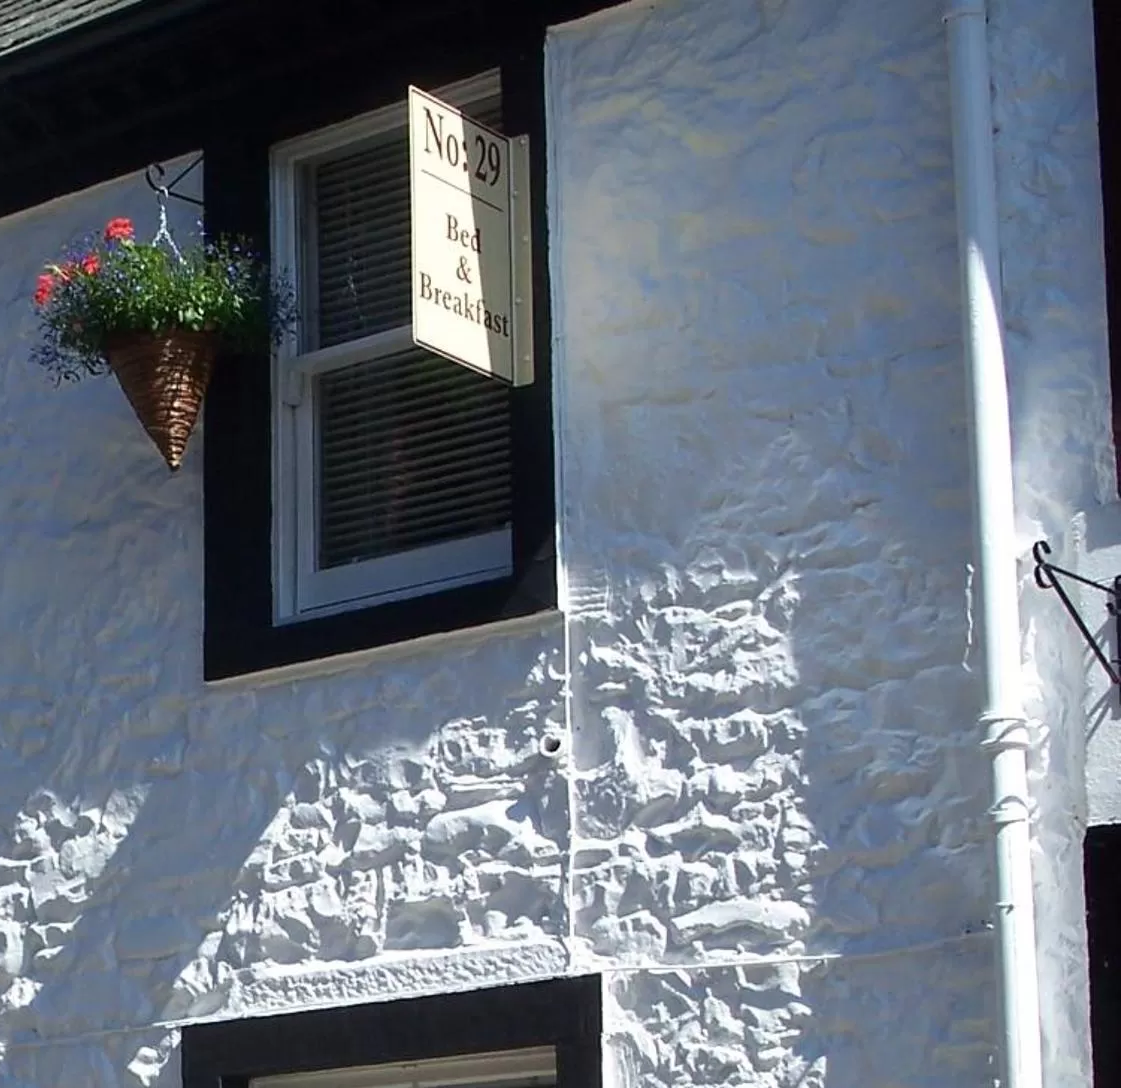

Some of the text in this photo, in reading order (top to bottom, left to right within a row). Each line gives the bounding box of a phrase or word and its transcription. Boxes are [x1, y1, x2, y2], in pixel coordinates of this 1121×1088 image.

[423, 106, 501, 188] No: 29
[446, 212, 482, 254] Bed
[456, 255, 472, 285] &
[419, 272, 510, 338] Breakfast
